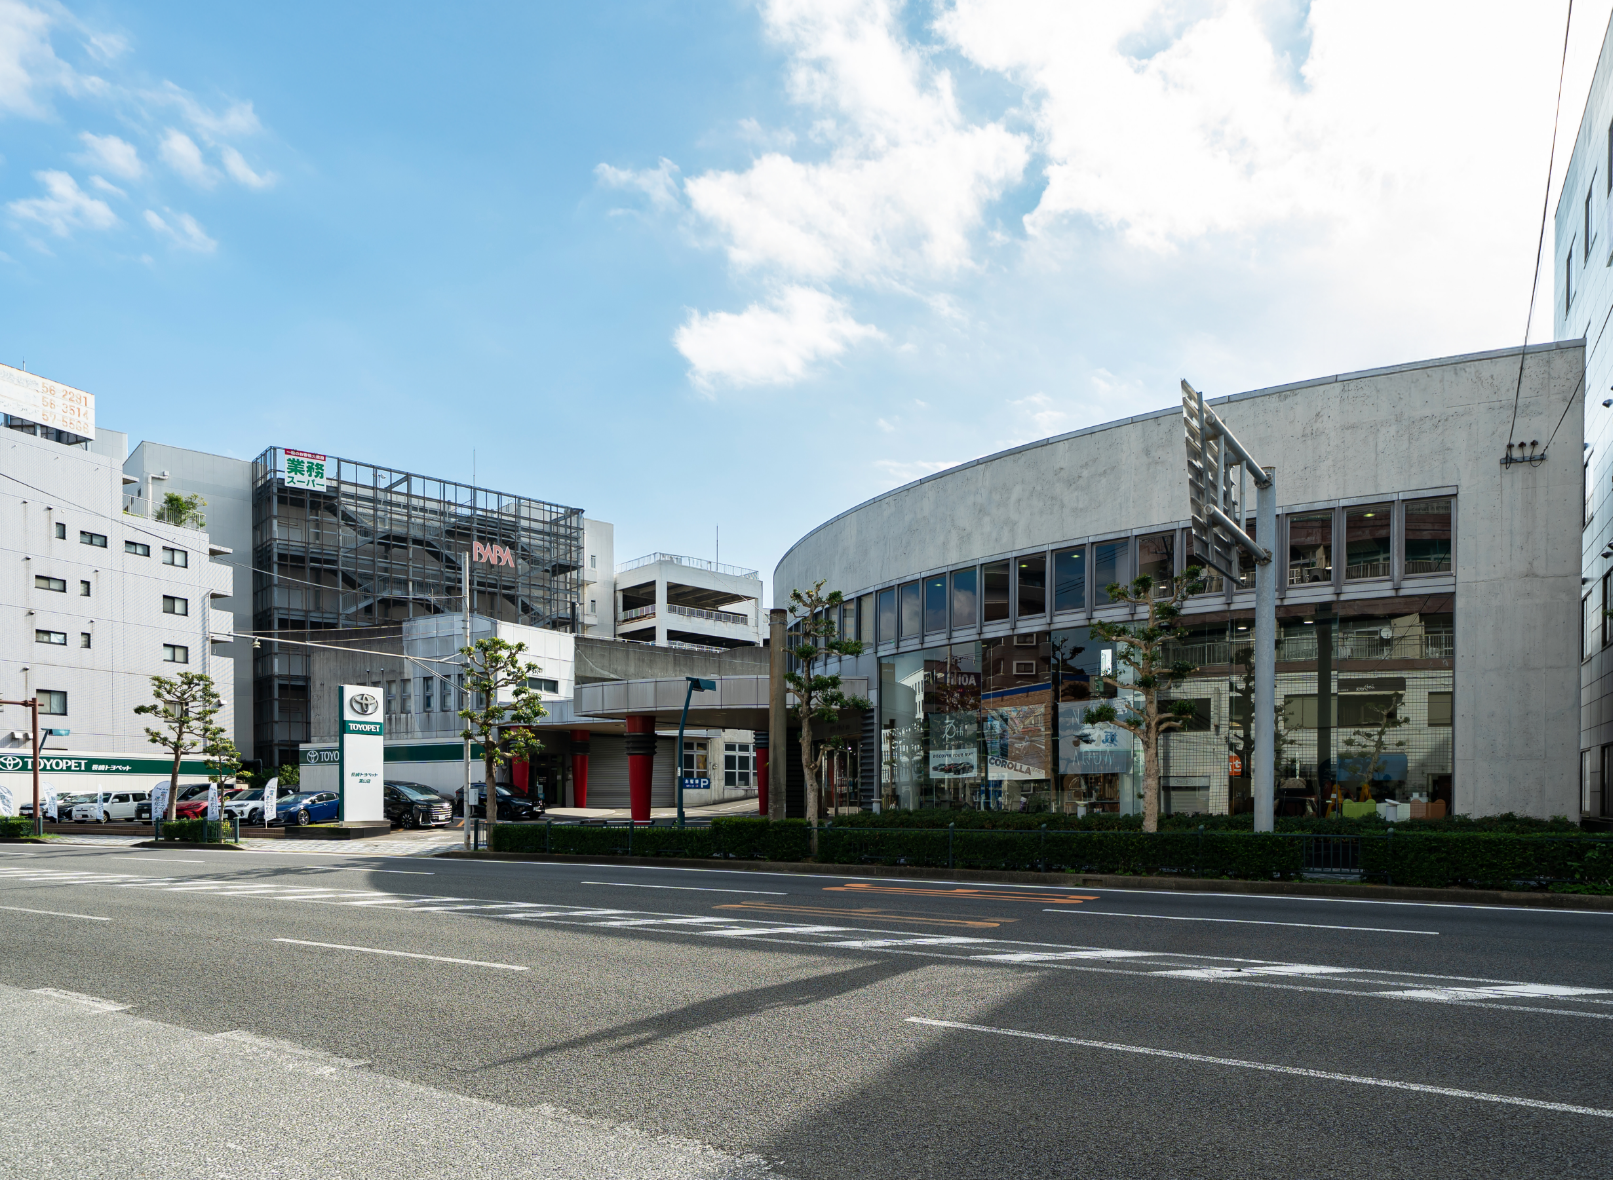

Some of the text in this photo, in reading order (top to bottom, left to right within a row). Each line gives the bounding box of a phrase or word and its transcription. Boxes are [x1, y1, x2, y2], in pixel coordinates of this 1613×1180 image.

[287, 457, 324, 479] 業務
[287, 475, 325, 487] スーパー
[348, 723, 380, 732] TOYOPET
[988, 757, 1032, 776] COROLLA
[701, 778, 709, 788] P
